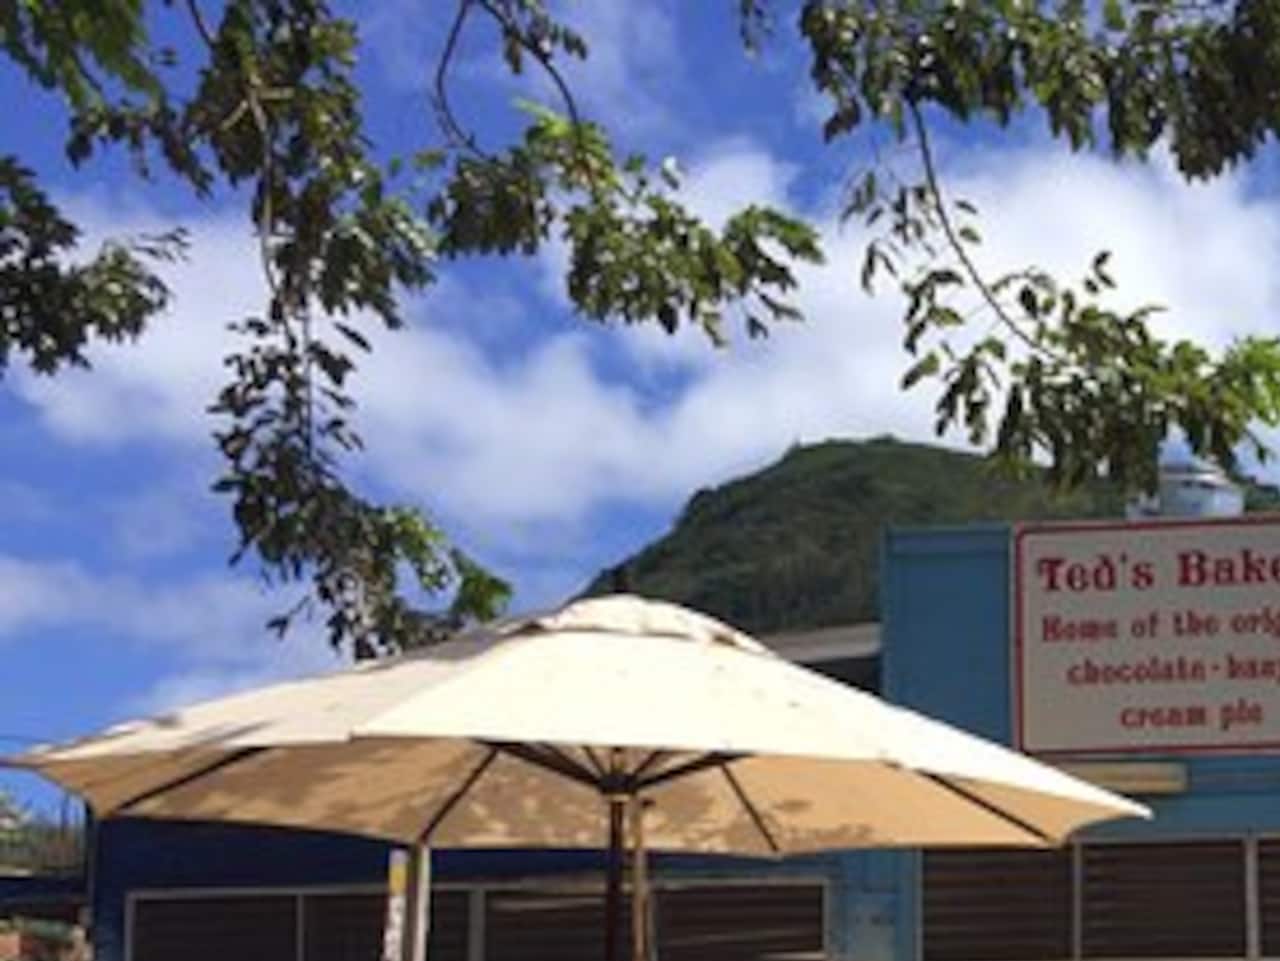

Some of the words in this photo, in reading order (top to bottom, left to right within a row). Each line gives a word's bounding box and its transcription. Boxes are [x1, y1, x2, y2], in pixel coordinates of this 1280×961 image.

[1037, 553, 1154, 592] Ted's
[1042, 614, 1118, 642] Home
[1131, 612, 1159, 639] of
[1173, 609, 1219, 637] the
[1120, 704, 1206, 728] cream
[1219, 699, 1263, 731] pie
